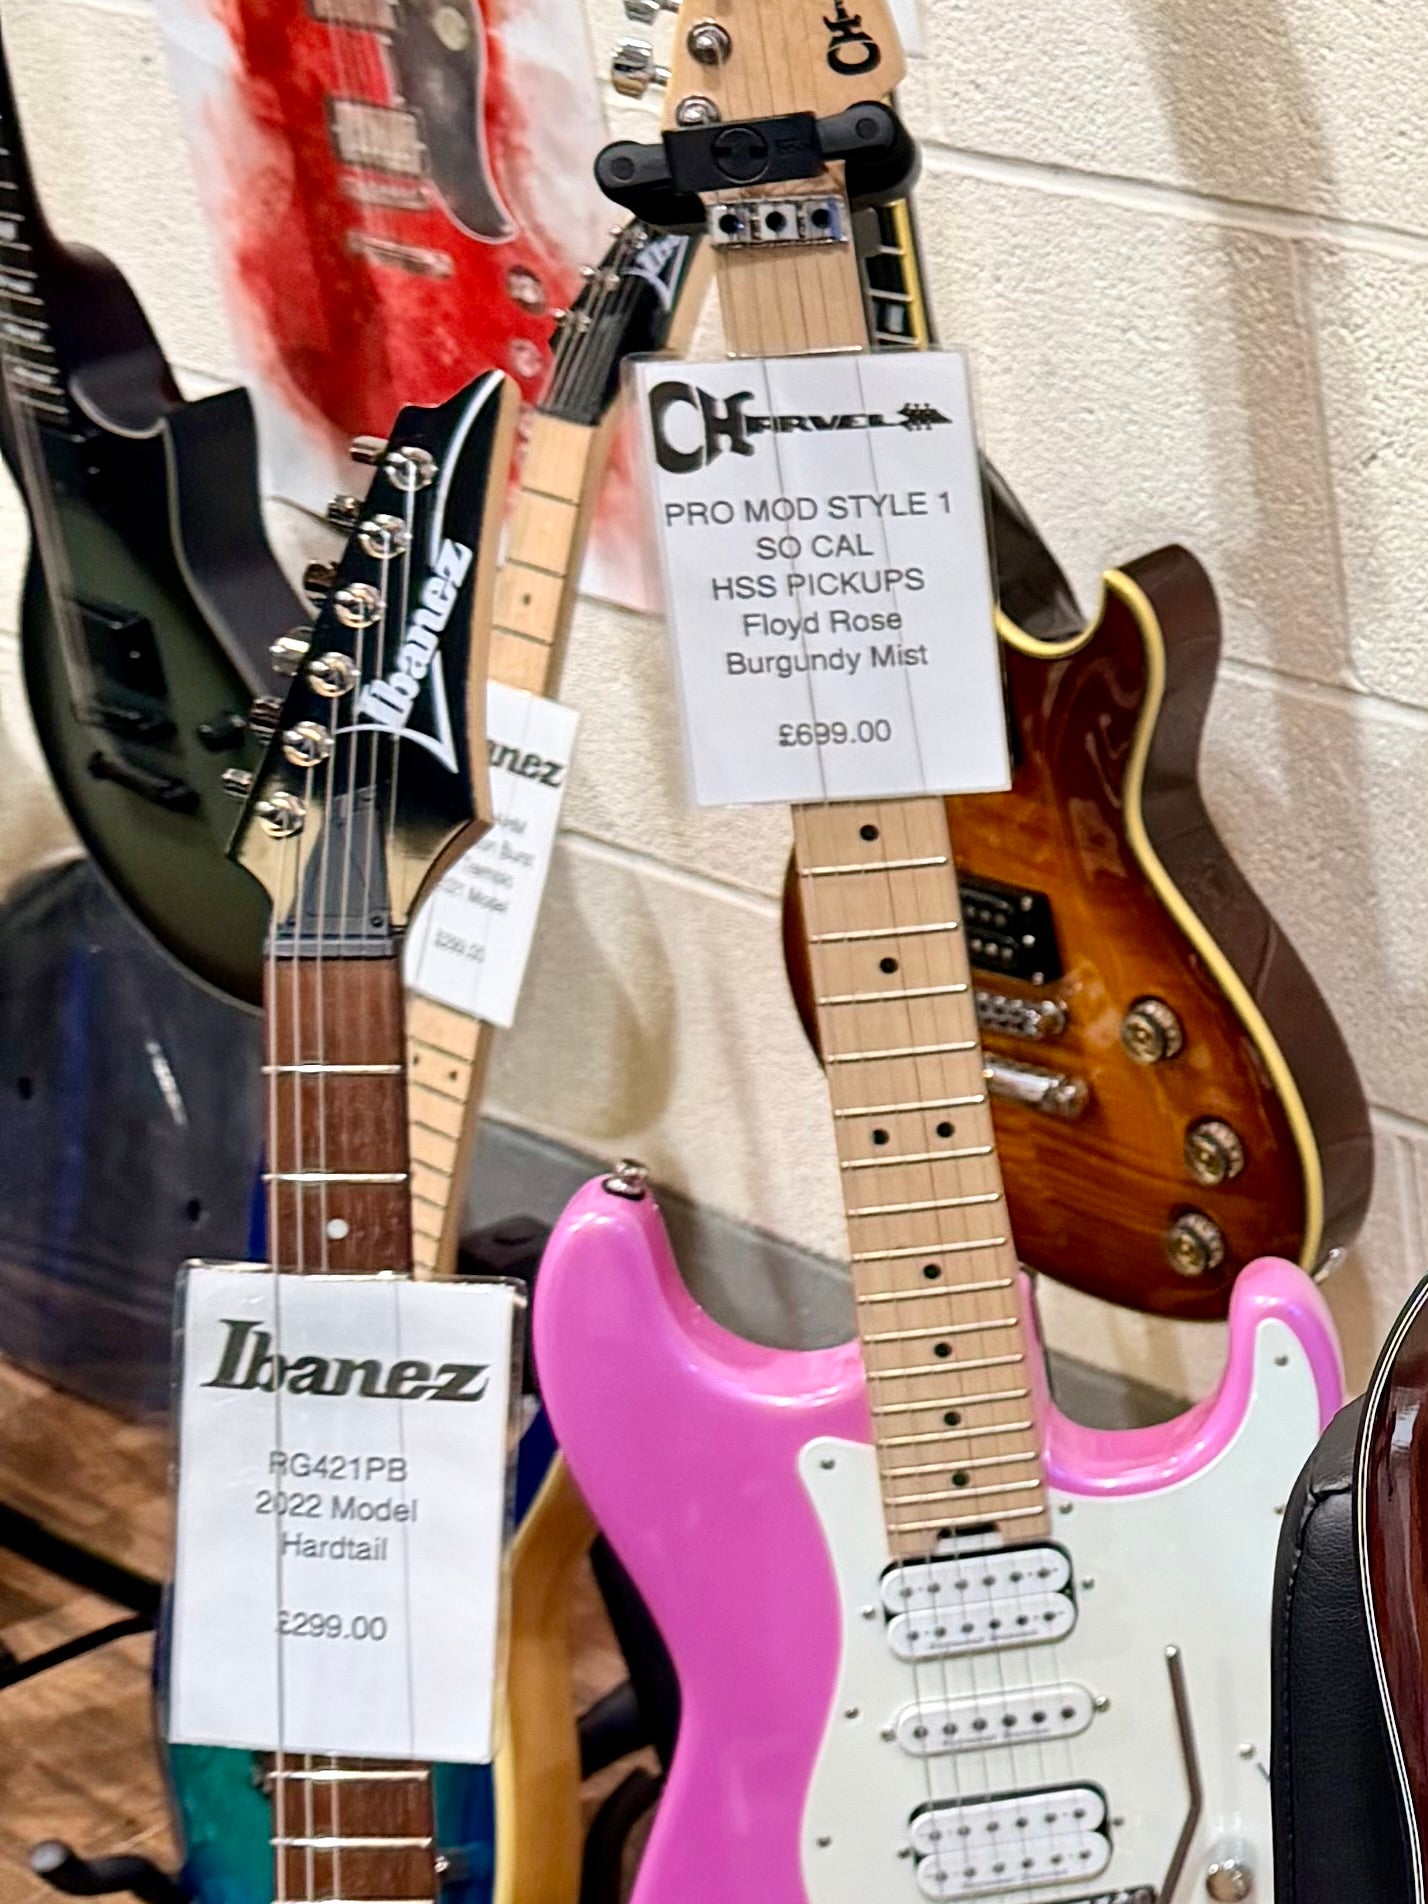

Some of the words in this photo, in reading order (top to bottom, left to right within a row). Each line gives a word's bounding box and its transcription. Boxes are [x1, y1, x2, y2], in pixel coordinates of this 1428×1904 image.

[665, 501, 734, 527] PRO
[744, 497, 817, 523] MOD
[828, 492, 928, 520] STYLE
[938, 492, 951, 515] 1
[756, 536, 802, 560] SO
[811, 534, 874, 558] CAL
[712, 576, 777, 601] HSS
[787, 568, 925, 596] PICKUPS
[356, 538, 473, 728] Ibanez
[743, 612, 820, 641] Floyd
[831, 610, 903, 634] Rose
[726, 647, 861, 678] Burgundy
[870, 645, 929, 668] Mist
[778, 719, 892, 748] £699.00
[200, 1318, 491, 1401] Ibanez
[269, 1451, 408, 1483] RG421PB
[255, 1491, 322, 1520] 2022
[331, 1495, 418, 1524] Model
[281, 1532, 388, 1562] Hardtail
[276, 1611, 388, 1642] £299.00
